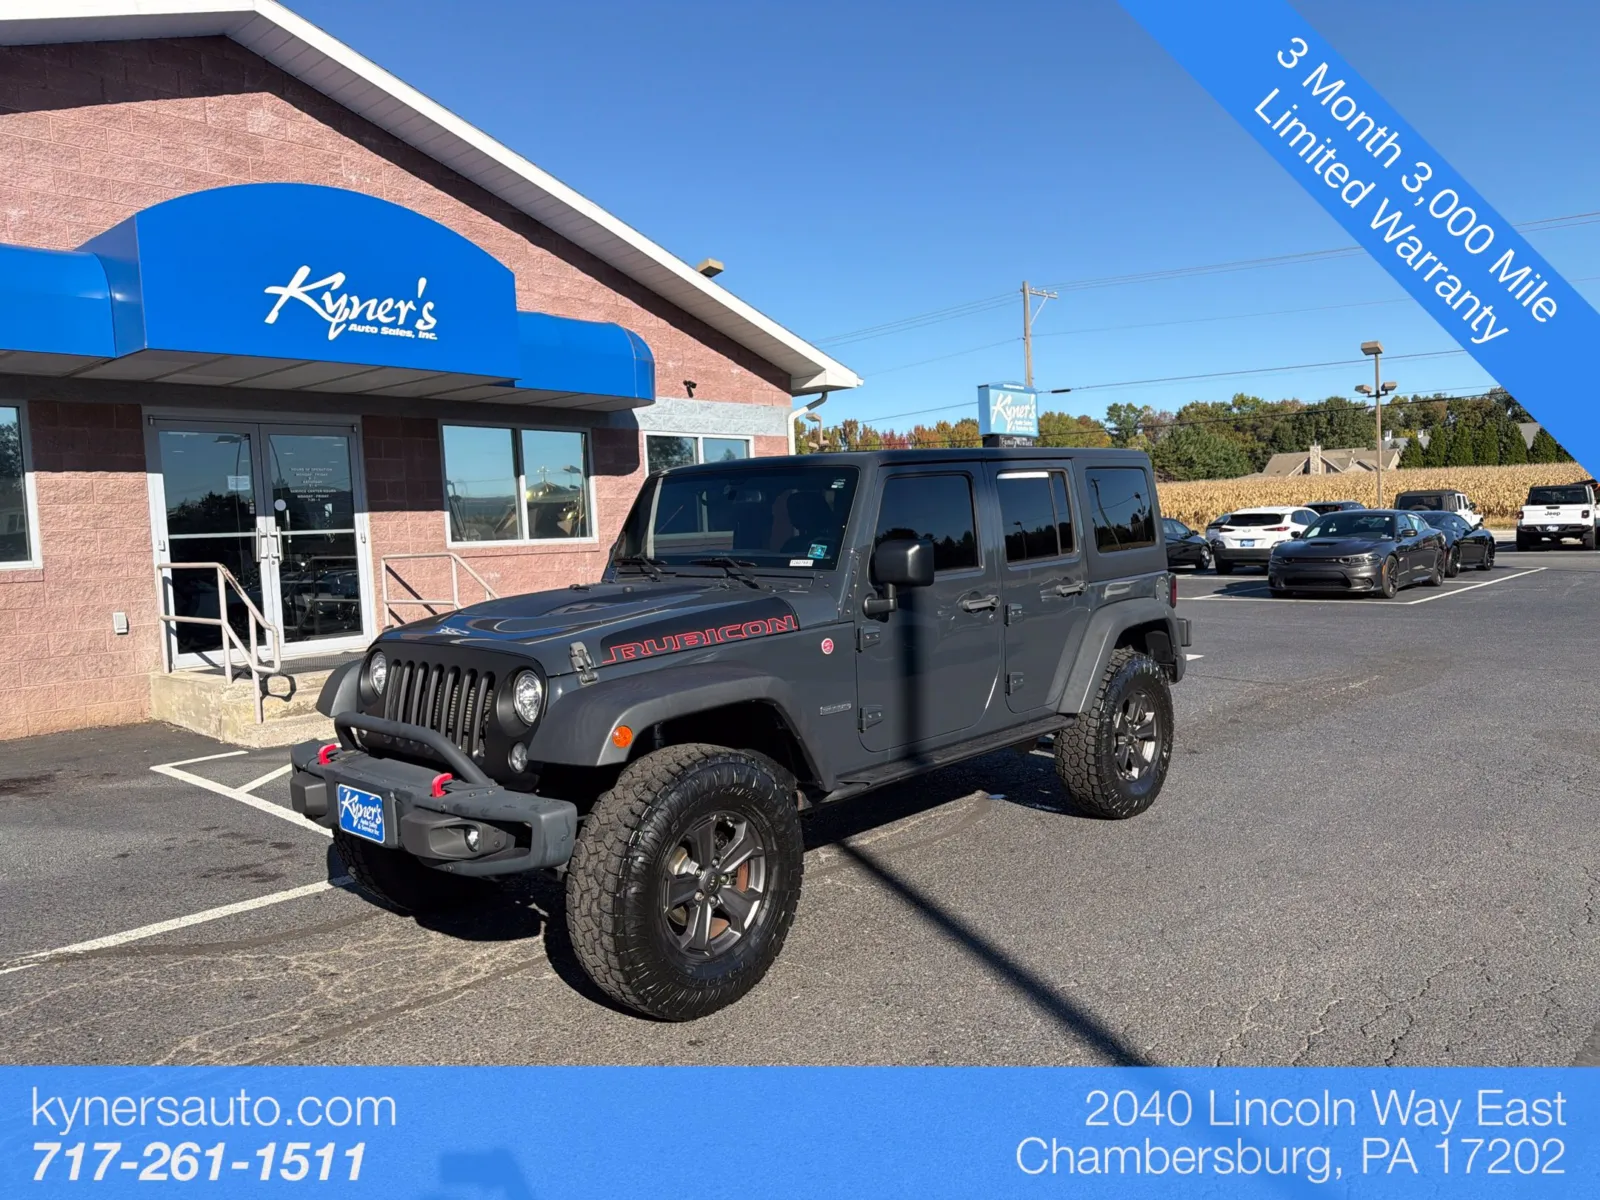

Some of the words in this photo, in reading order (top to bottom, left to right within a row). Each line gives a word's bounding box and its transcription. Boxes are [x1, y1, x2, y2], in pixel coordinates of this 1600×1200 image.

[264, 265, 437, 340] Kyner's
[348, 323, 379, 334] Auto
[381, 326, 415, 339] Sales,
[418, 330, 438, 340] Inc.
[991, 392, 1036, 432] Kyner's
[602, 615, 798, 664] RUBICON
[341, 791, 382, 827] Kyner's
